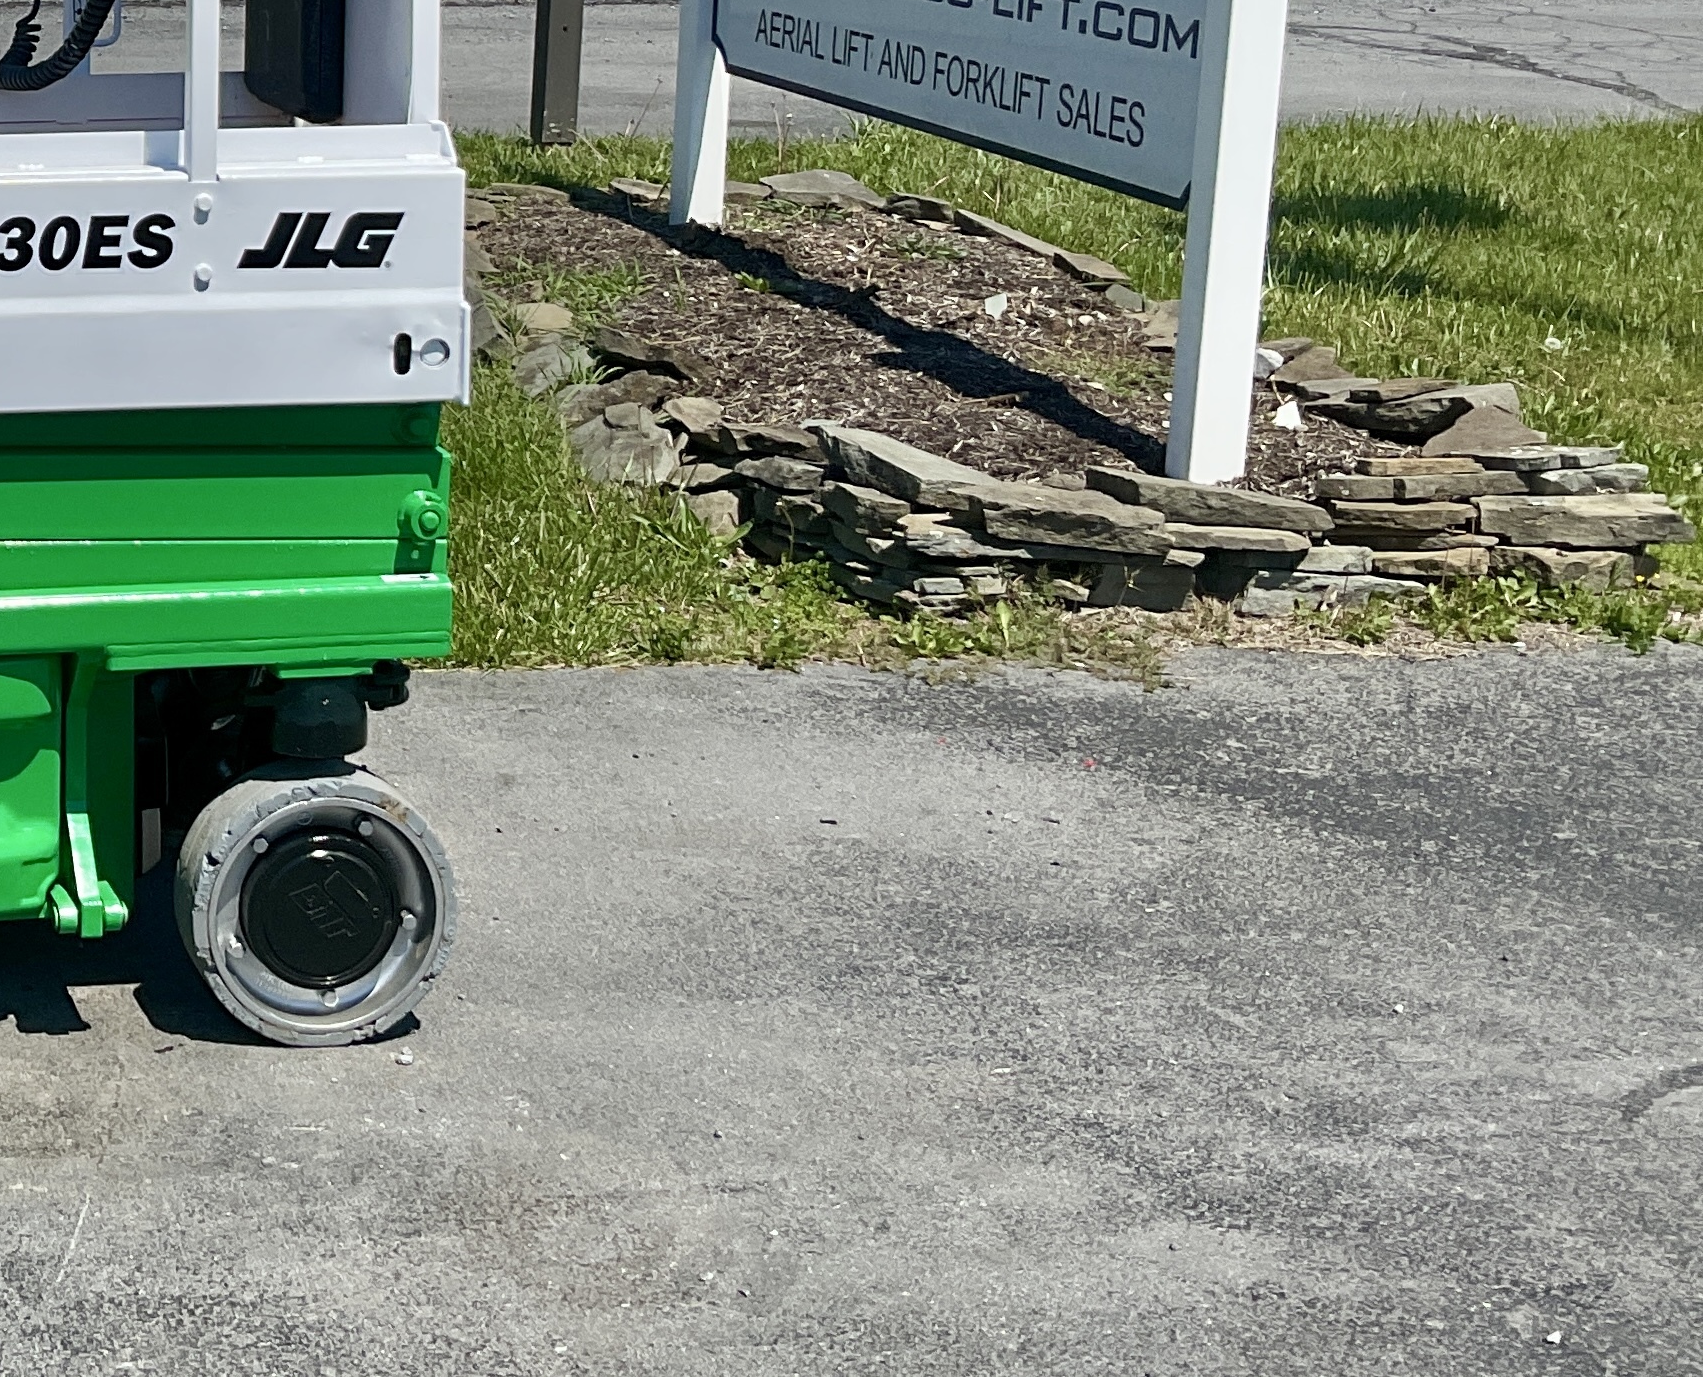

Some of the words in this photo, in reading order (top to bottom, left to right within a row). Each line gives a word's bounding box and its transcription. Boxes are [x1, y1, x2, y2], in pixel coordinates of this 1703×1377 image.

[754, 7, 825, 60] AERIAL
[831, 25, 875, 72] LIFT
[877, 38, 926, 86] AND
[932, 51, 1051, 121] FORKLIFT
[1056, 82, 1146, 148] SALES
[236, 211, 405, 270] JLG
